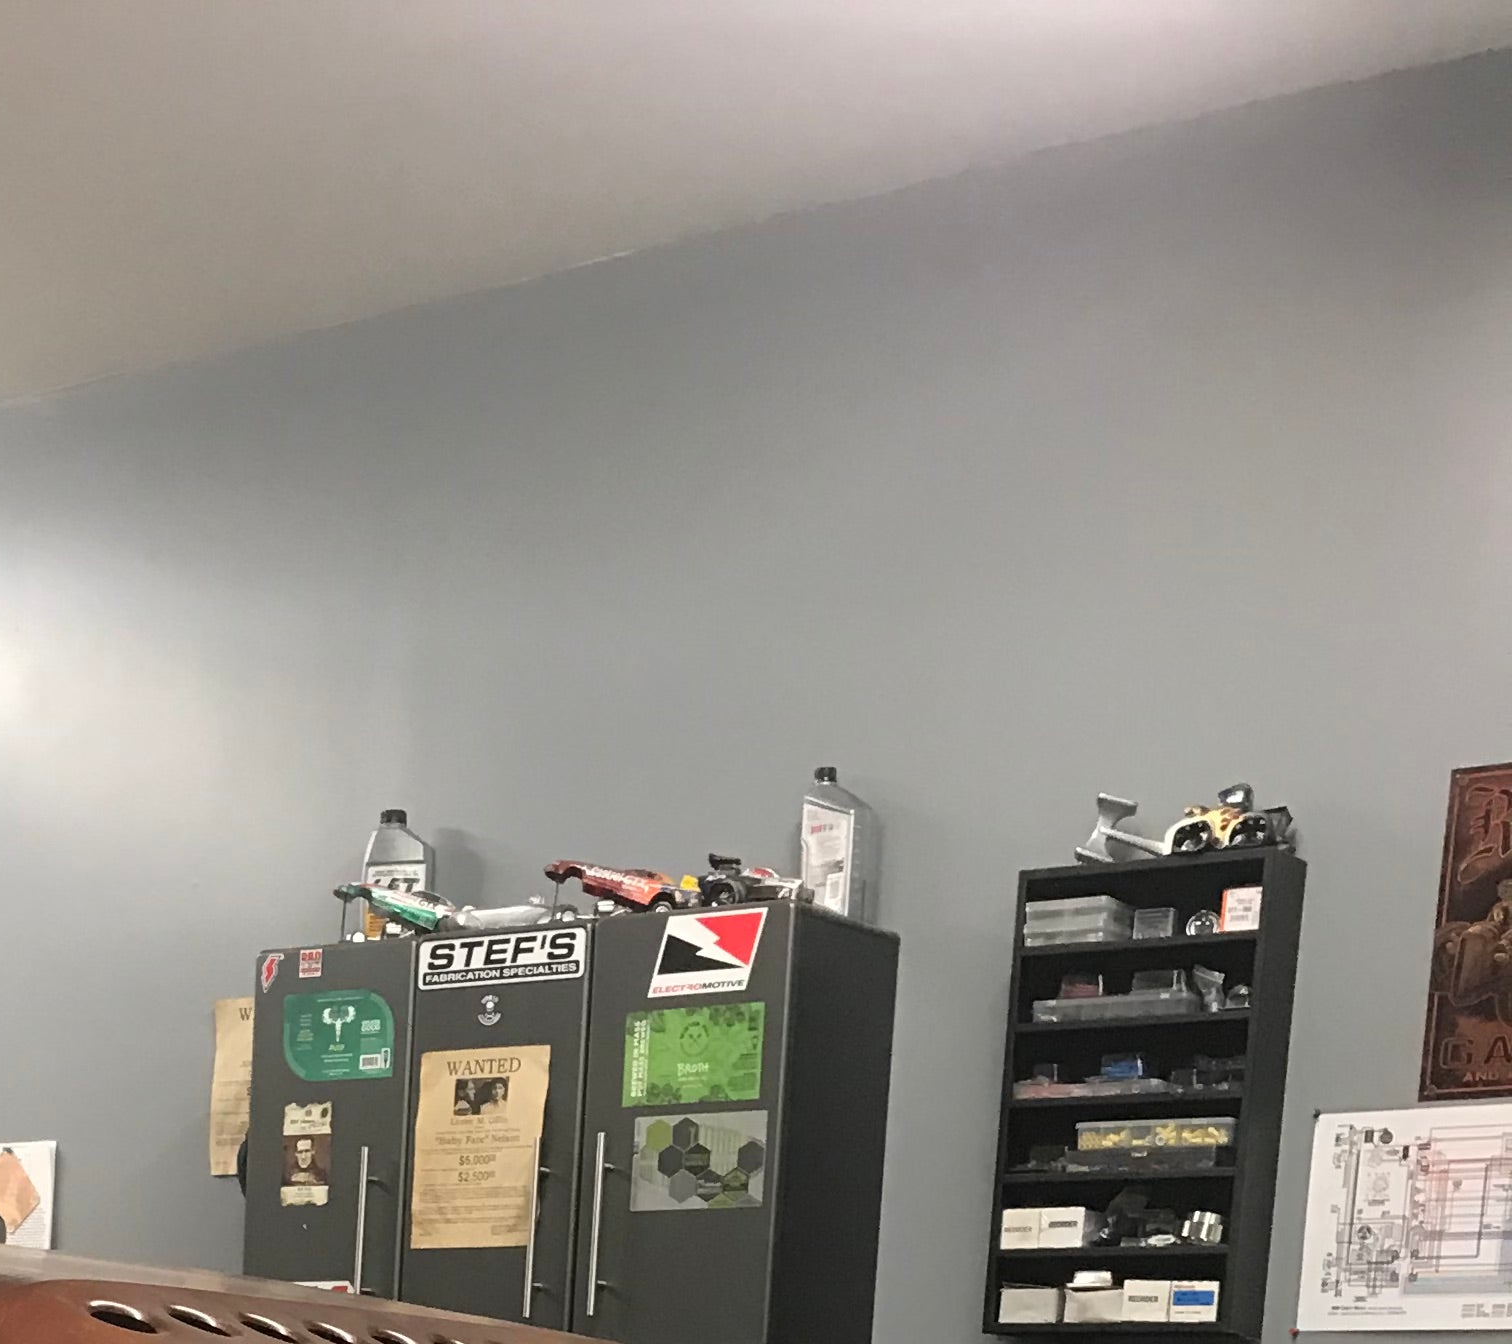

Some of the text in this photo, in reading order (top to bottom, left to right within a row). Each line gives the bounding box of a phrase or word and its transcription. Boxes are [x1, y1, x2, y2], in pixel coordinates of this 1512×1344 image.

[427, 932, 577, 970] STEF'S
[425, 963, 577, 984] FABRICATION SPECIALTIES
[652, 979, 745, 994] ELECTROMOTIVE
[447, 1057, 522, 1076] WANTED
[677, 1062, 710, 1077] BROTH
